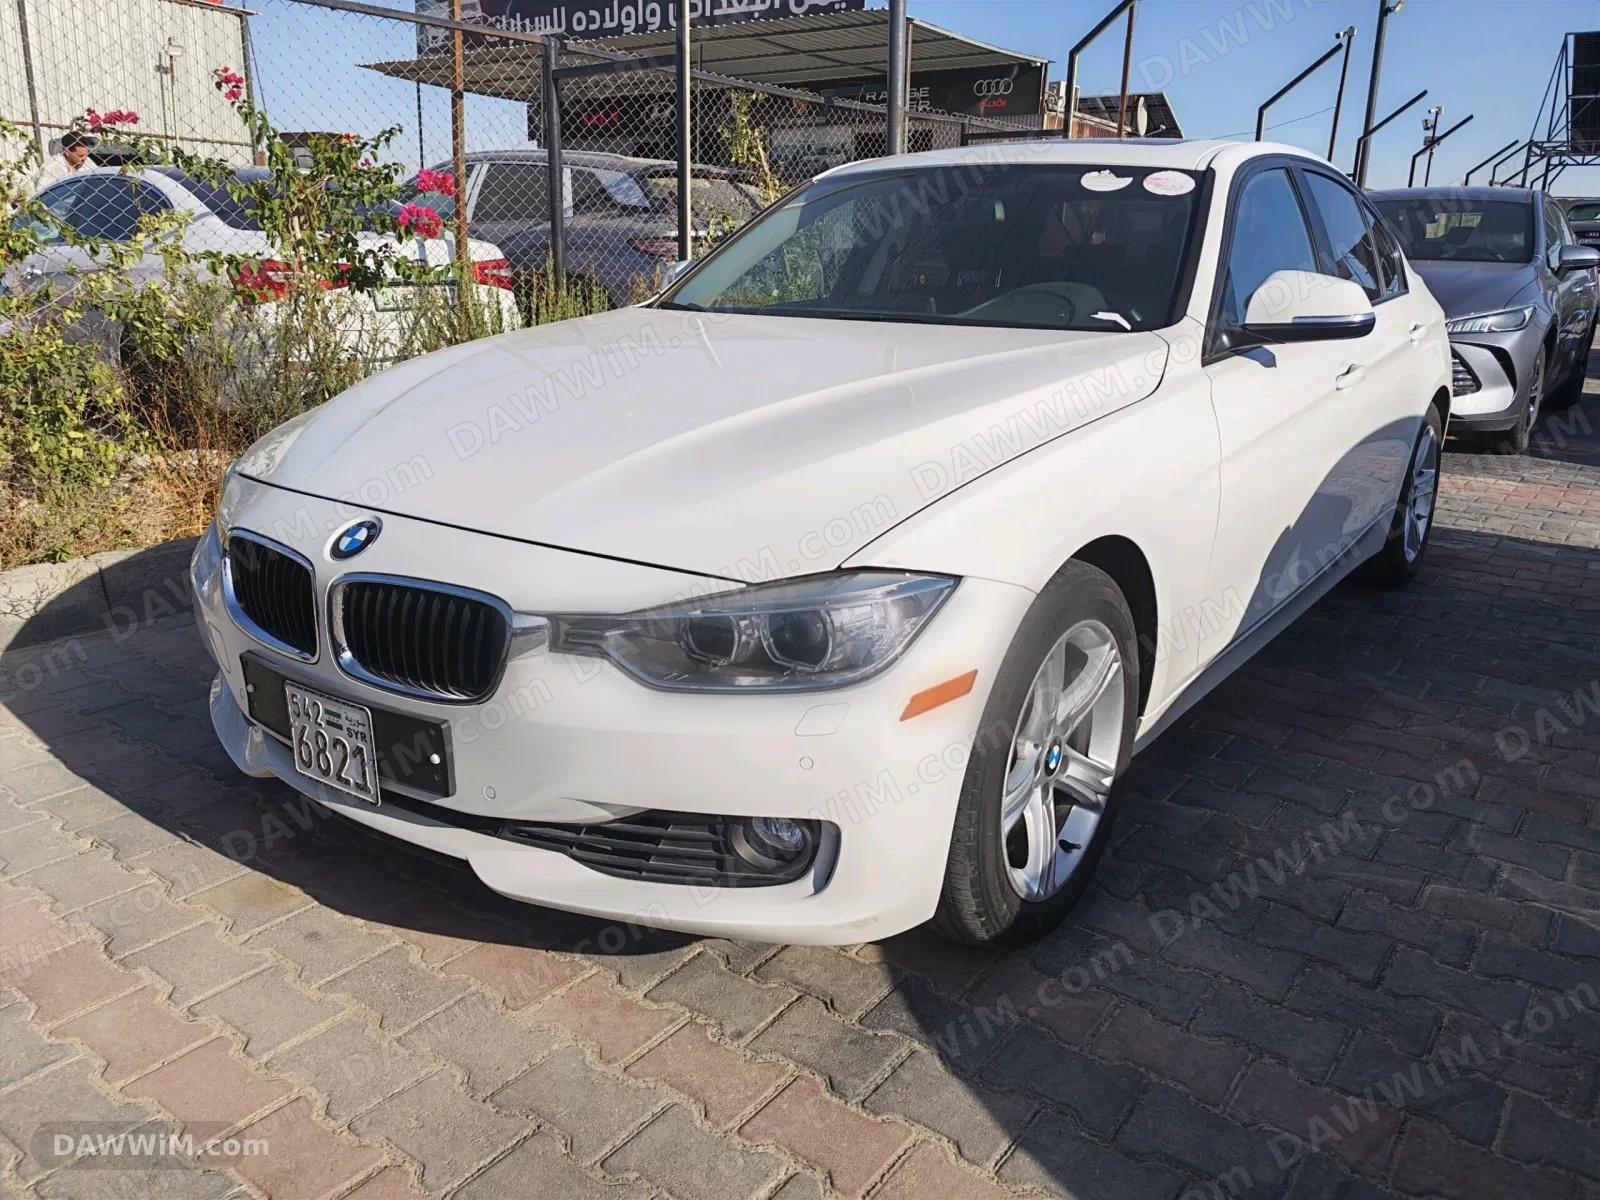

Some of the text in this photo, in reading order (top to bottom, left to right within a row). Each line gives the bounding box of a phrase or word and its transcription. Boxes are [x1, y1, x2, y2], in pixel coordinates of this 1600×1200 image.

[866, 87, 930, 101] RAGE
[291, 693, 325, 728] 542
[345, 710, 366, 728] سورية
[346, 727, 368, 744] SYR
[298, 724, 375, 795] 6821
